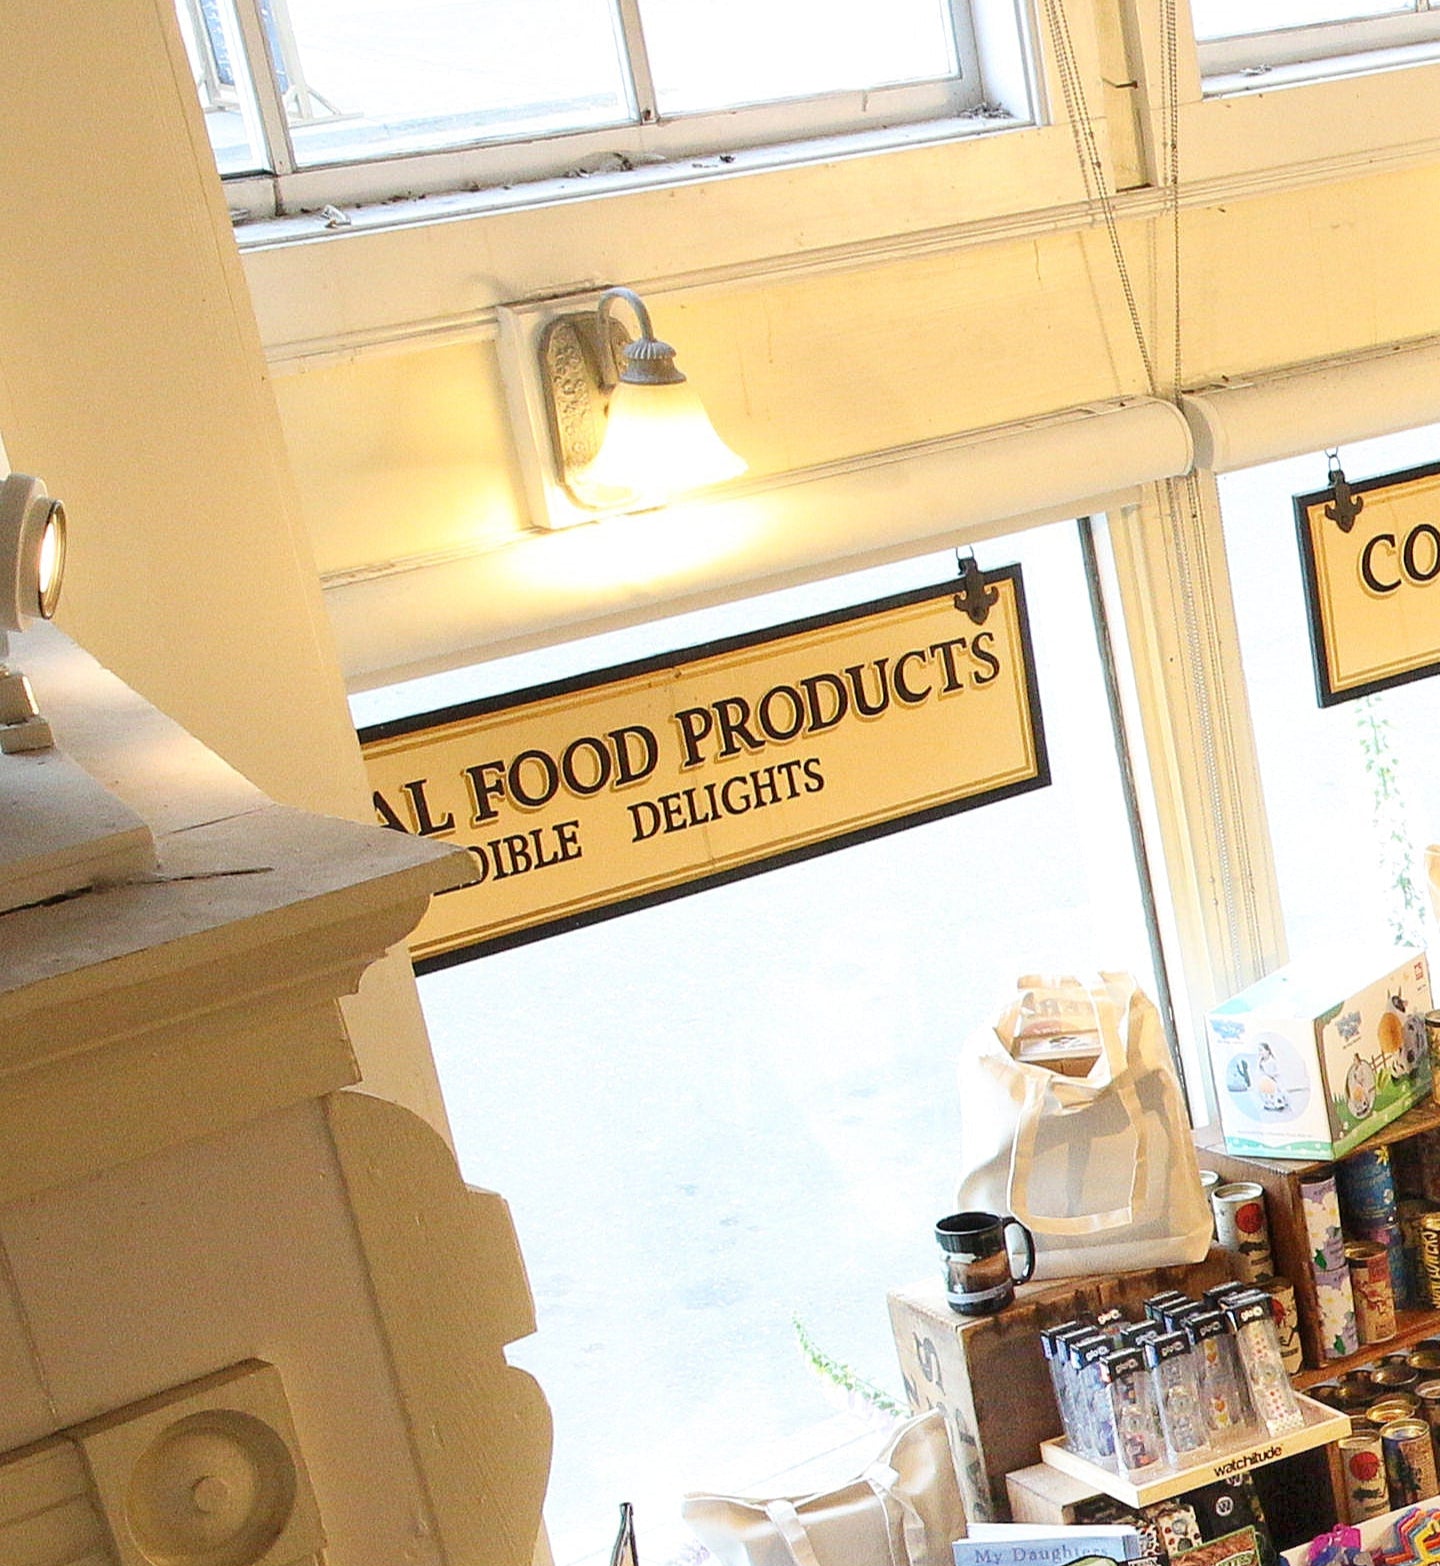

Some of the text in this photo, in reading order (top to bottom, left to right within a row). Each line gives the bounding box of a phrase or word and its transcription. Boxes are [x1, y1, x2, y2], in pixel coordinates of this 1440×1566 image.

[465, 630, 1002, 823] FOOD PRODUCTS
[630, 757, 827, 844] DELIGHTS
[1213, 1444, 1283, 1480] watchitude
[974, 1548, 1002, 1565] My
